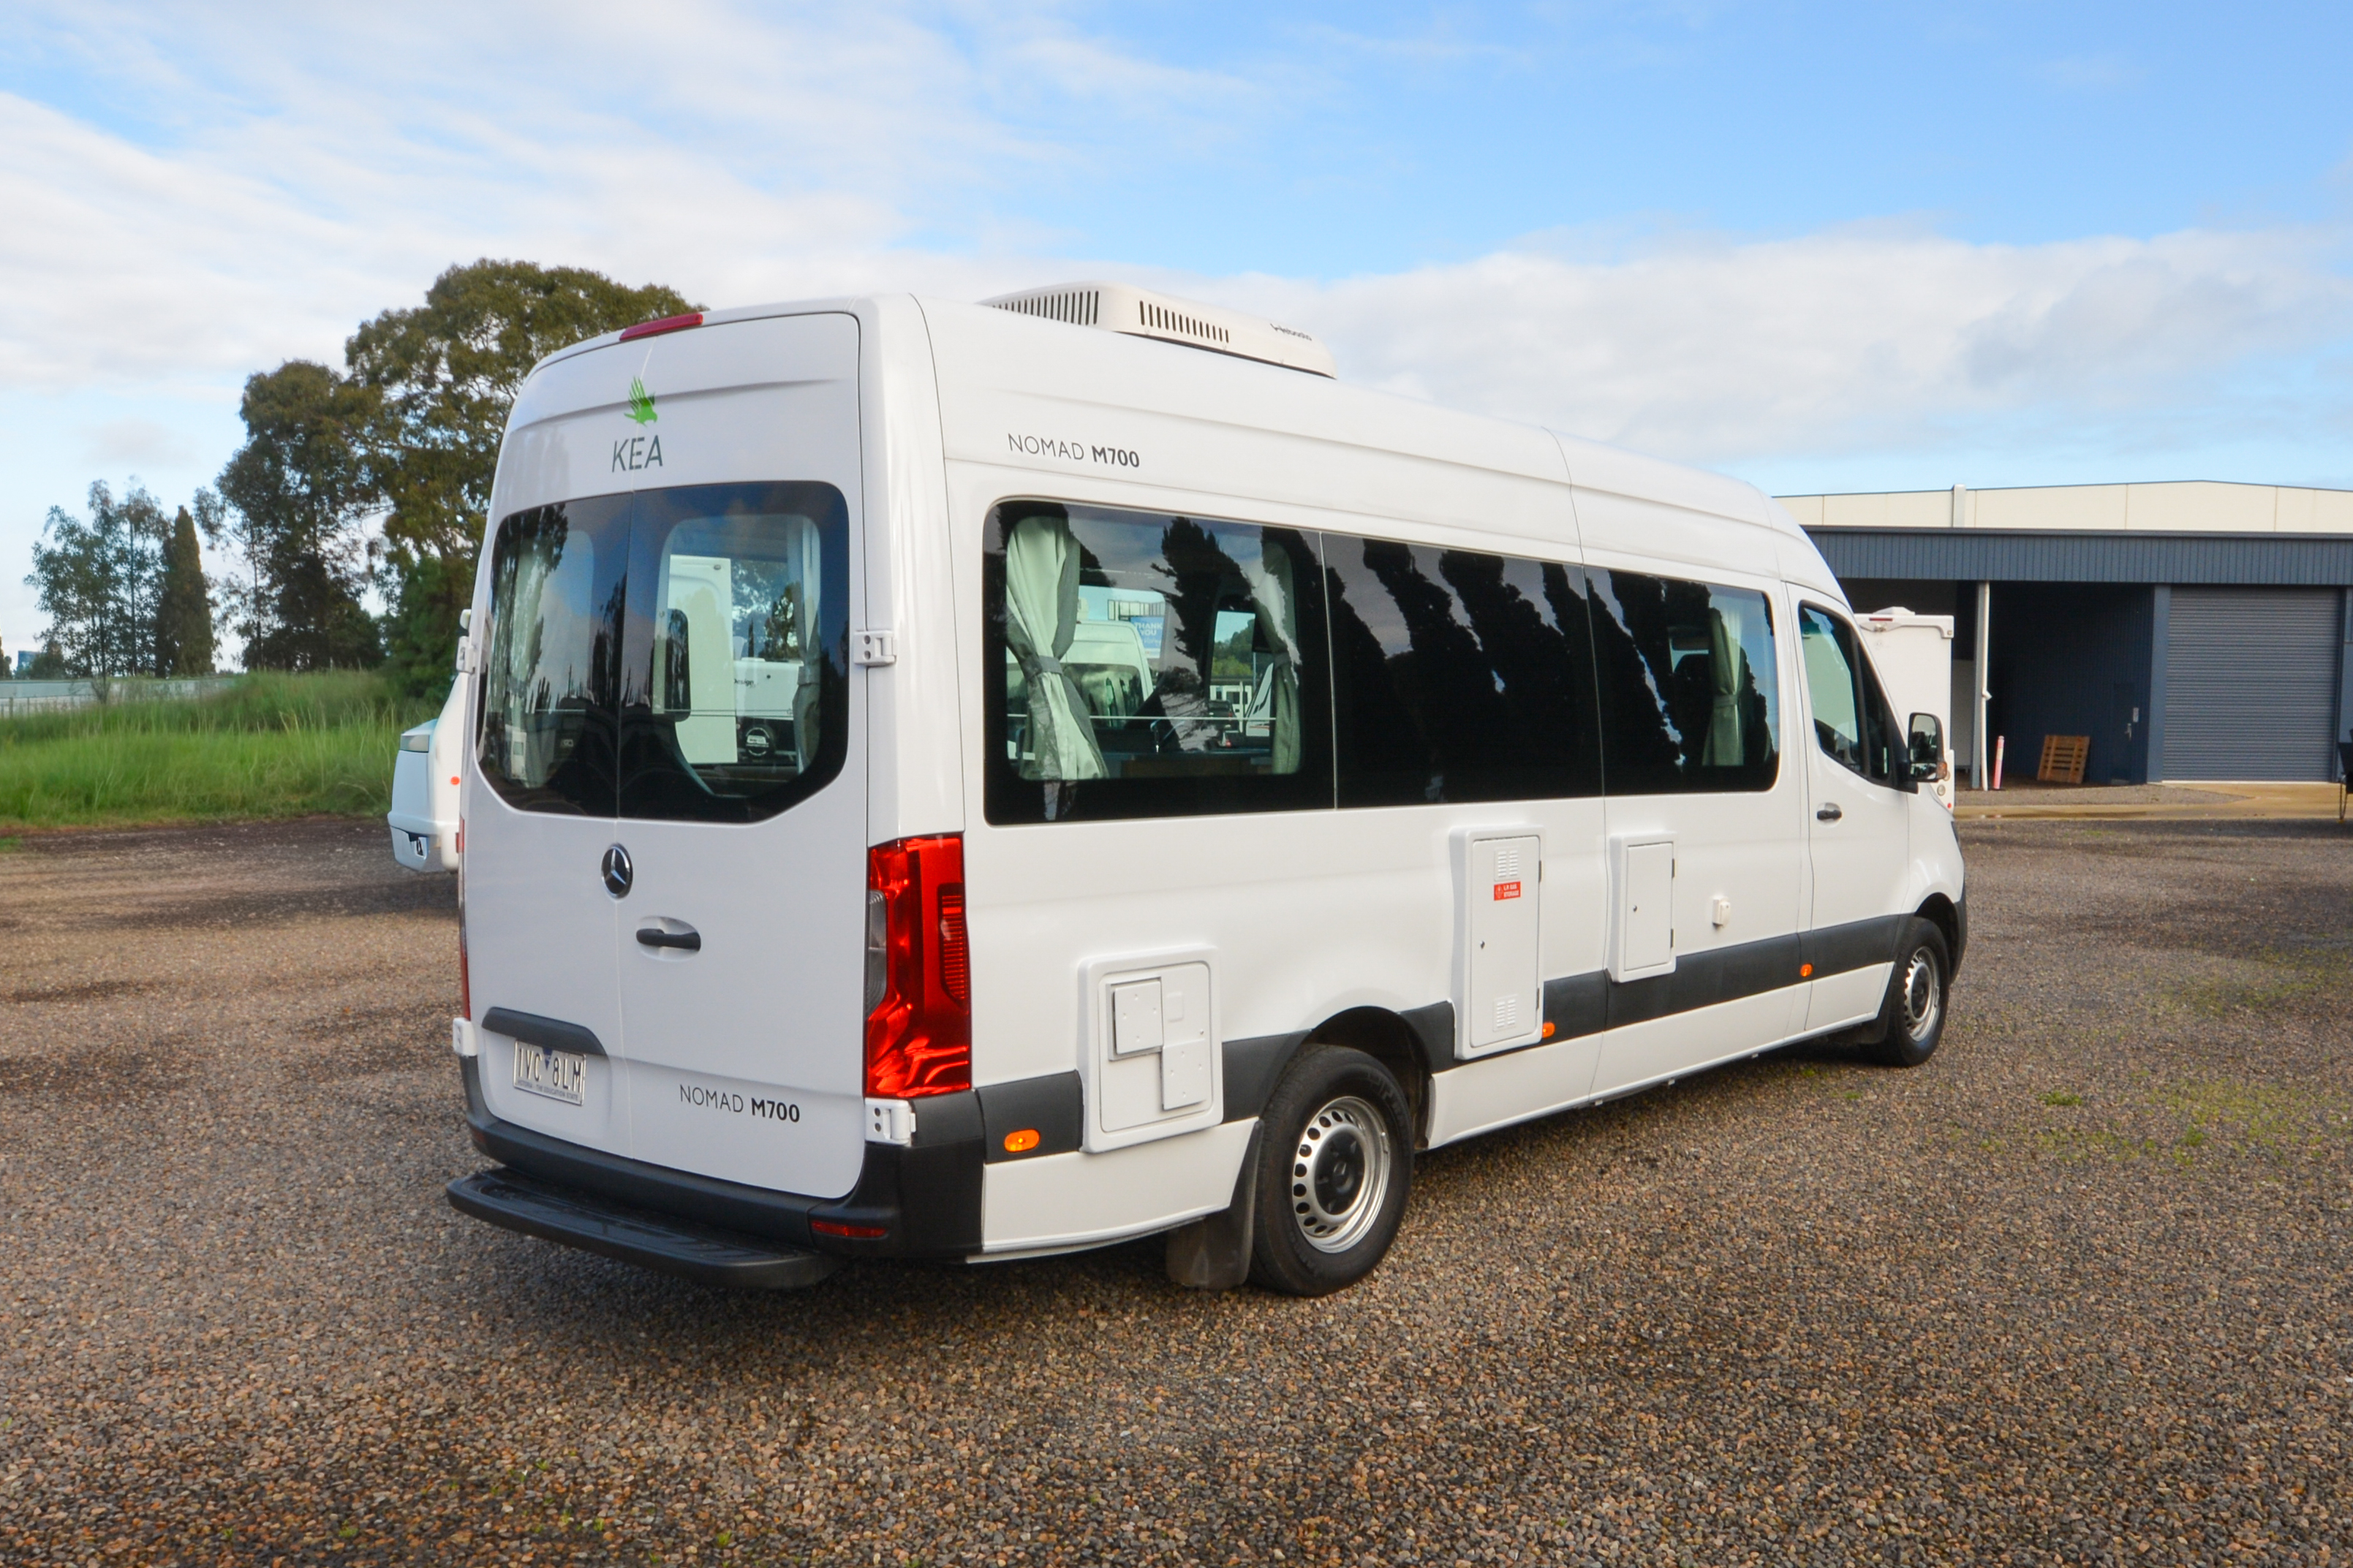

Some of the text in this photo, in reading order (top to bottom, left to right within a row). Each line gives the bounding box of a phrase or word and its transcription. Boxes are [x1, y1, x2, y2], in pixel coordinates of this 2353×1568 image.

[611, 434, 663, 473] KEA
[1008, 433, 1140, 468] NOMAD M700
[553, 1057, 583, 1094] 8LM
[679, 1084, 800, 1123] NOMAD M700
